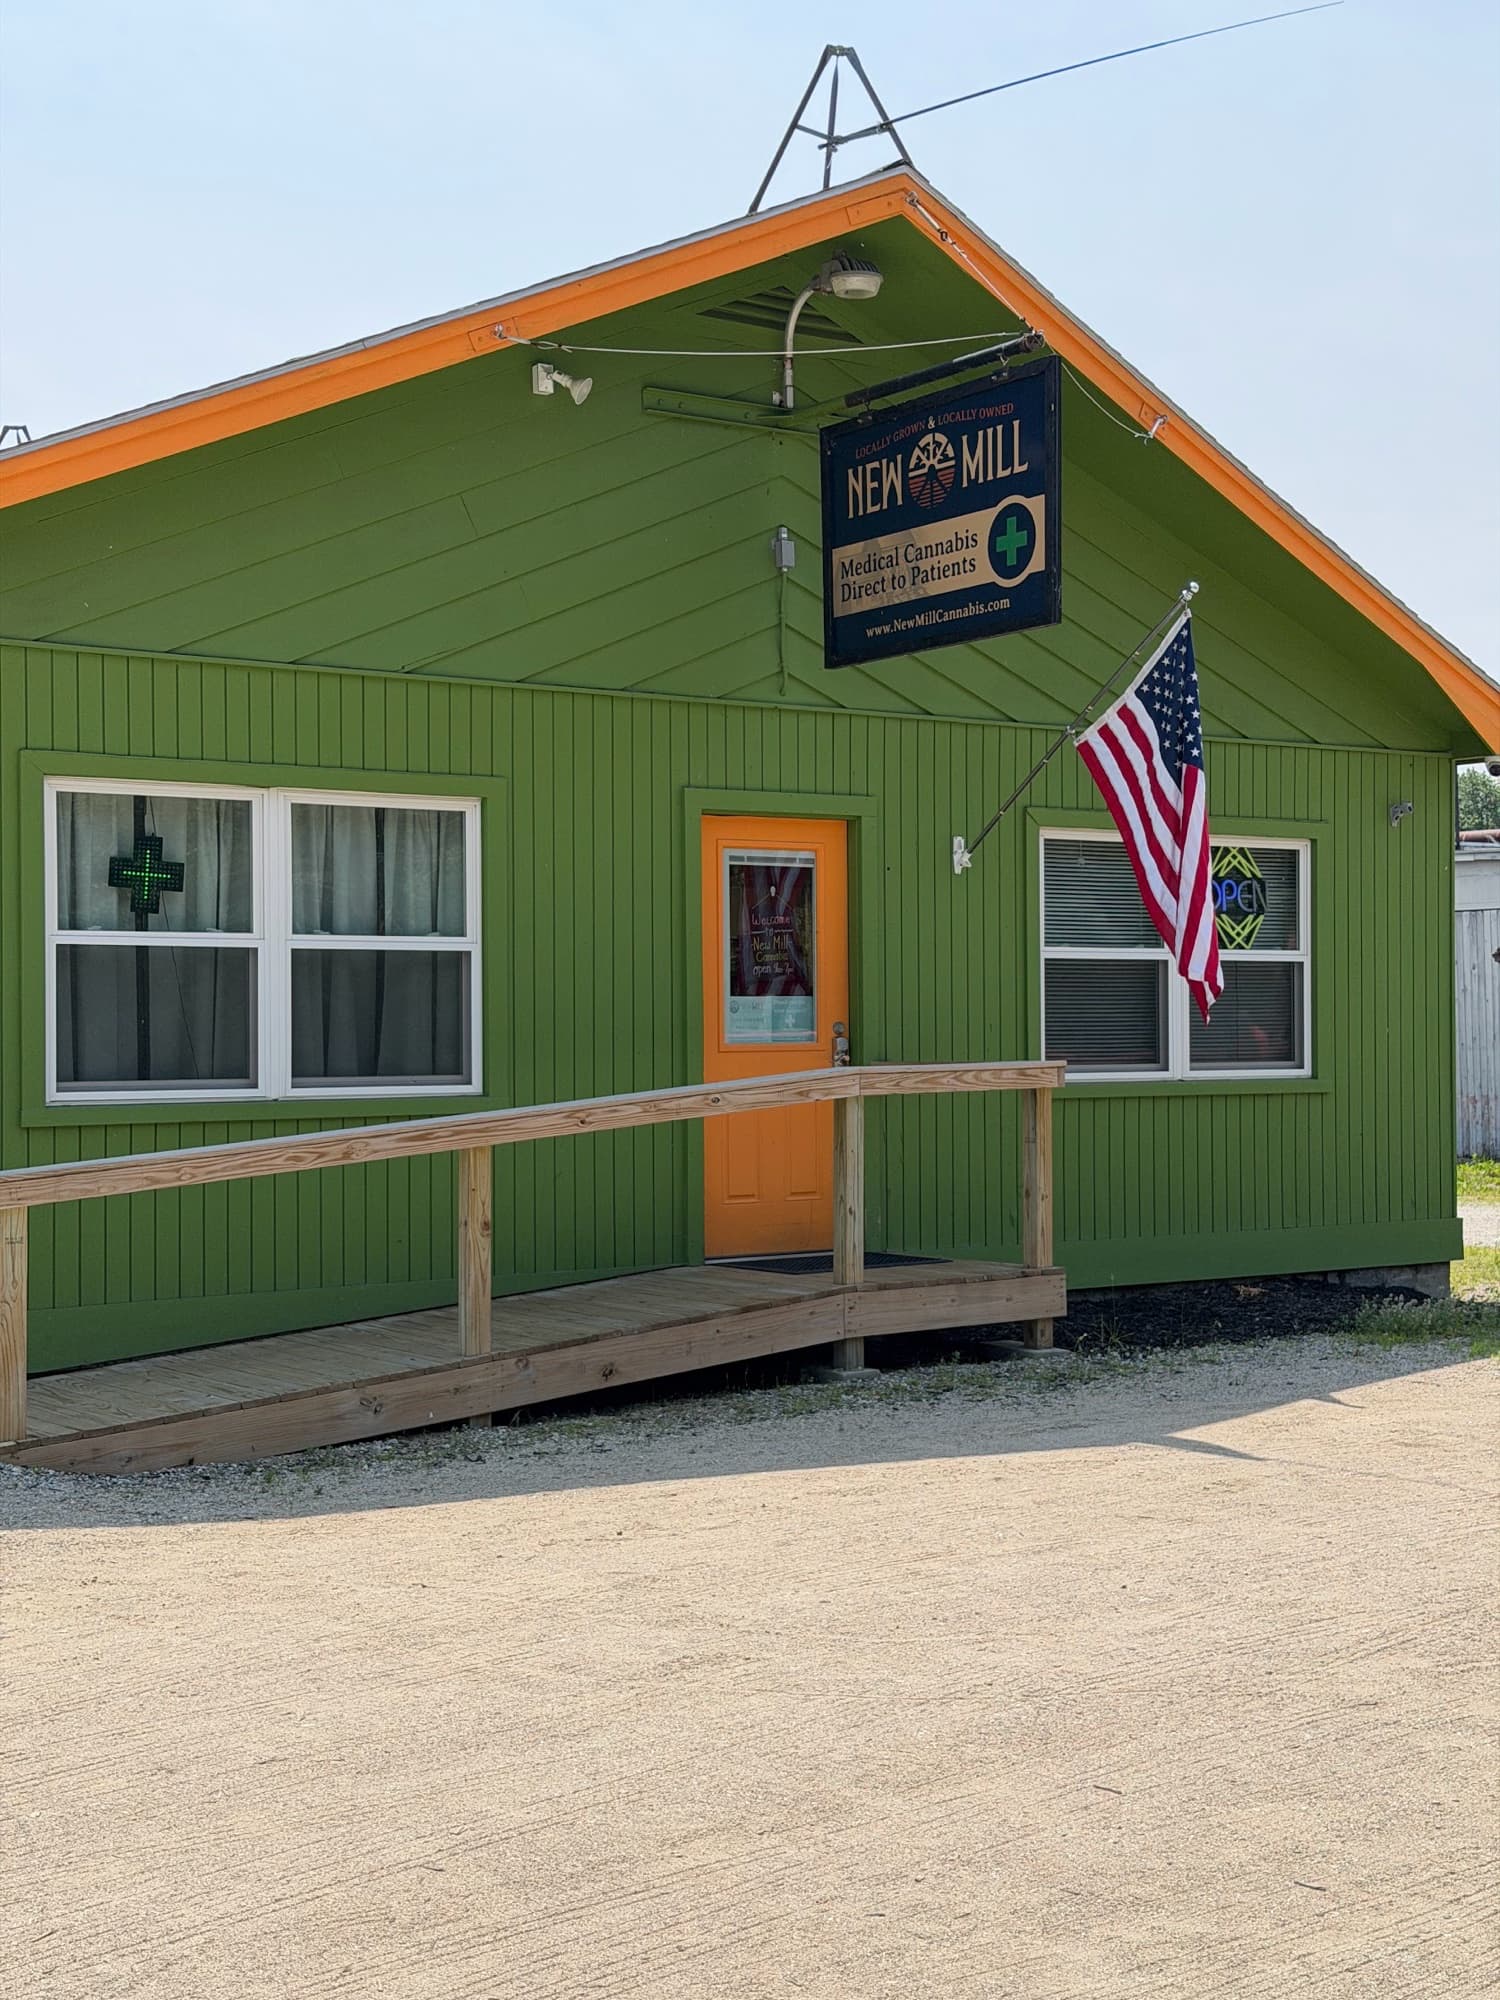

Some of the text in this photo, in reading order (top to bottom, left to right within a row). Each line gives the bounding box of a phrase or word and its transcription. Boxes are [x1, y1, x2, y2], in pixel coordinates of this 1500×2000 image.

[855, 434, 891, 460] LOCALLY
[892, 420, 926, 443] GROWN
[937, 408, 978, 426] LOCALLY
[978, 402, 1015, 420] OWNED
[847, 419, 1029, 519] NEW MILL
[840, 529, 978, 580] Medical Cannabis
[841, 557, 977, 603] Direct to Patients
[865, 598, 1010, 638] www.NewMillCannabis.com
